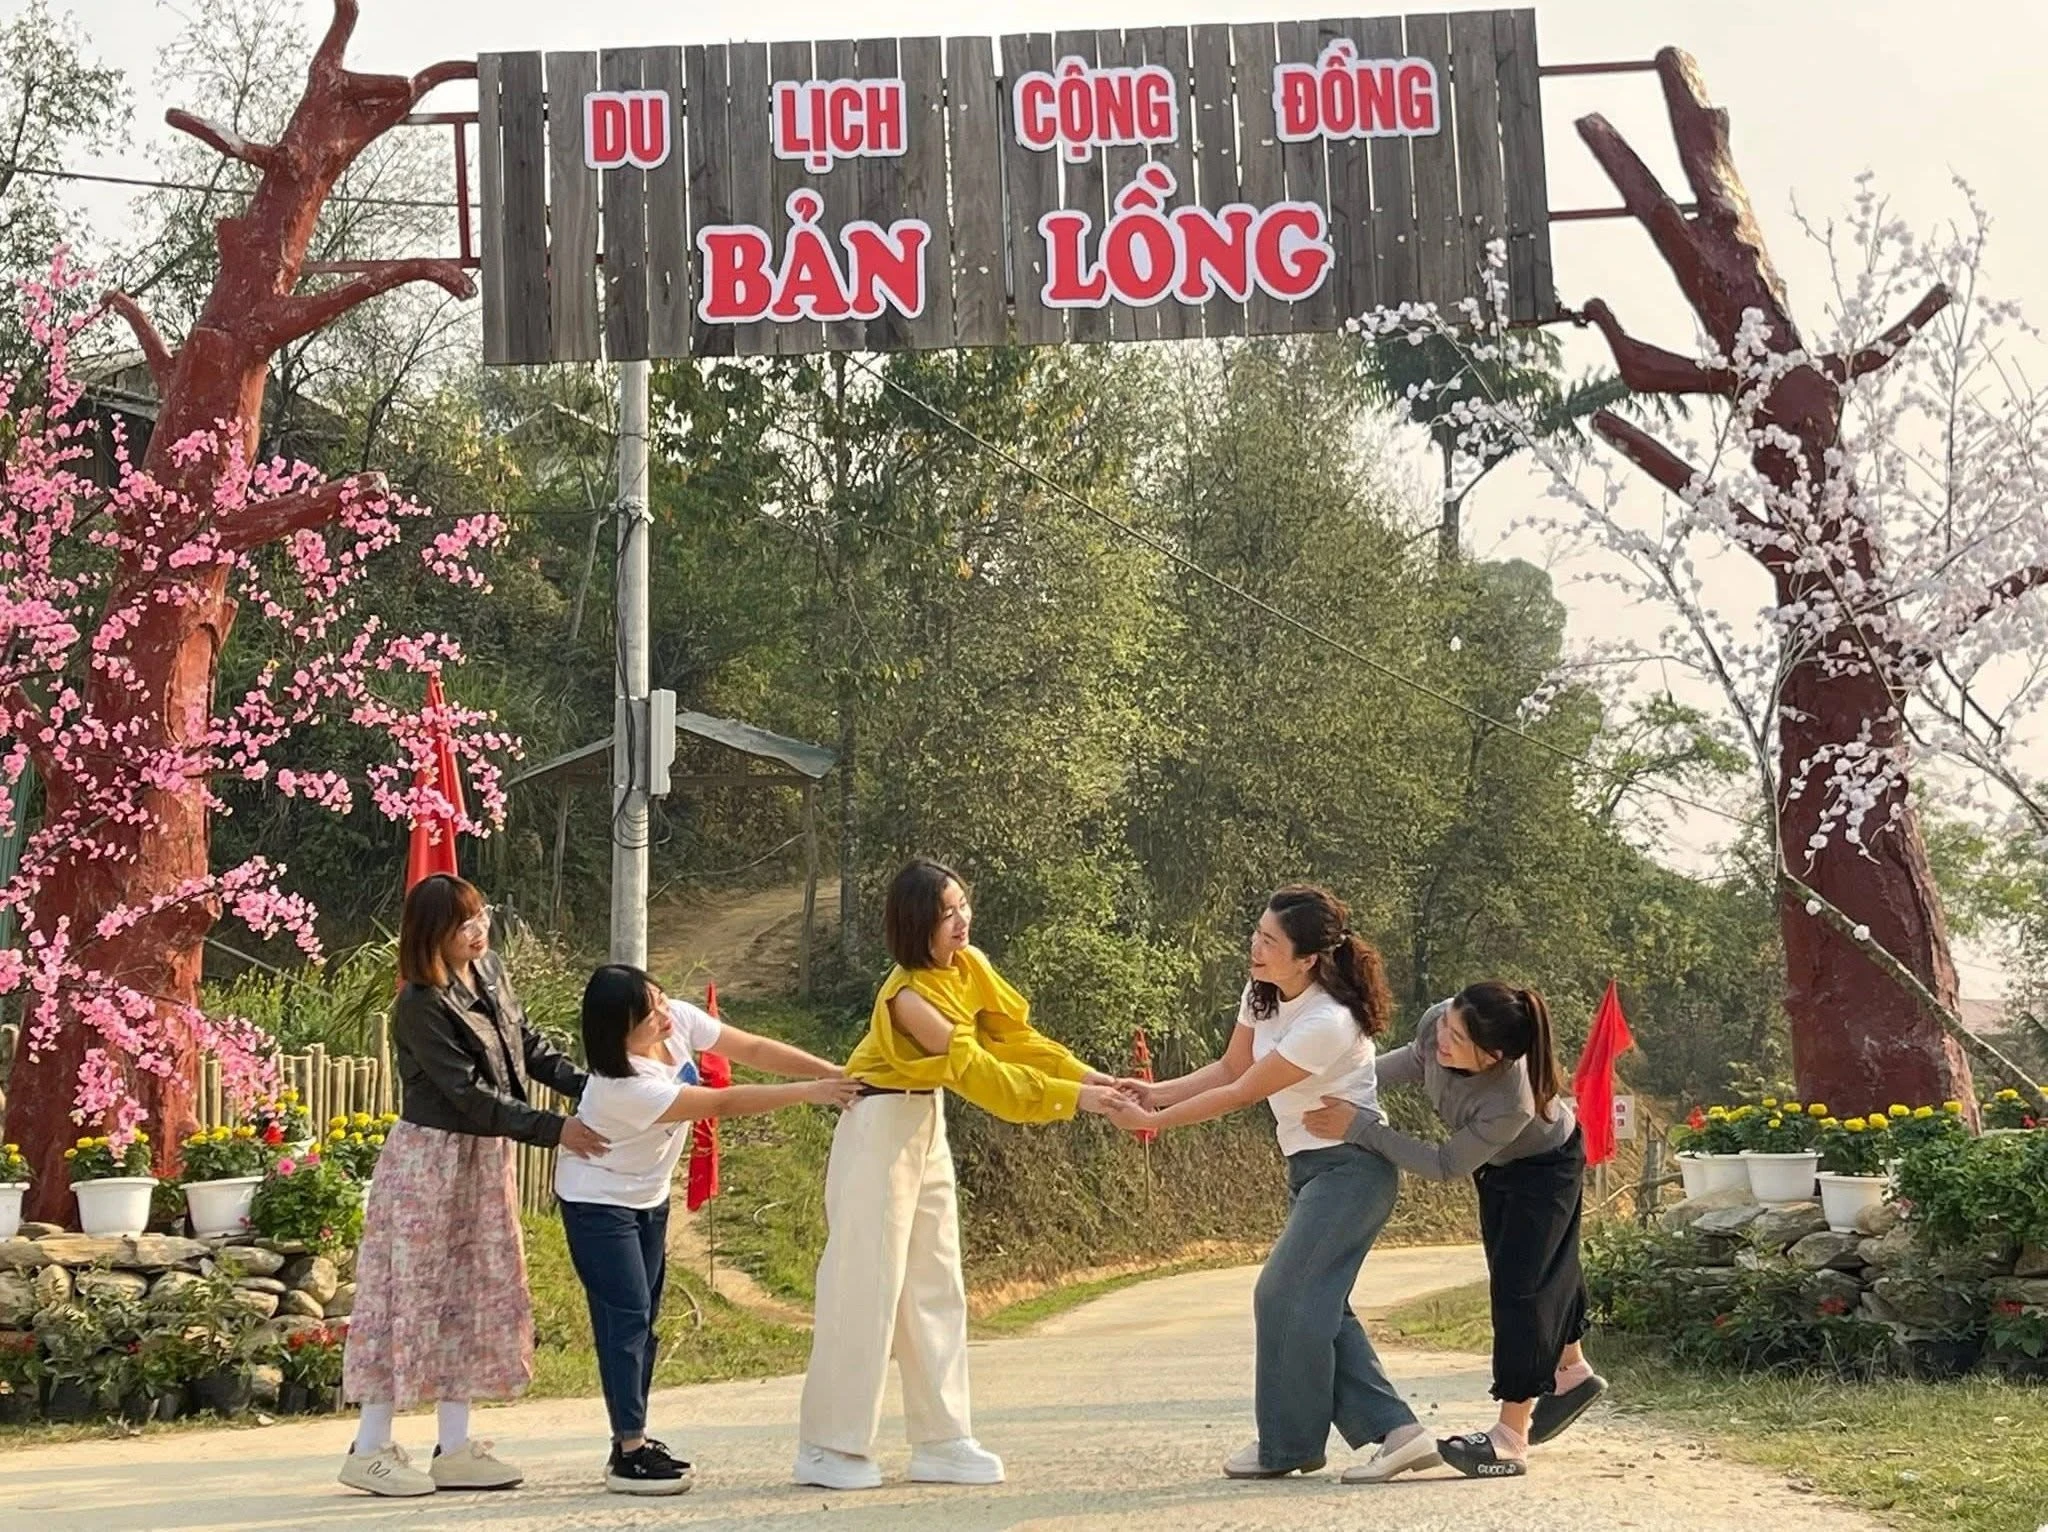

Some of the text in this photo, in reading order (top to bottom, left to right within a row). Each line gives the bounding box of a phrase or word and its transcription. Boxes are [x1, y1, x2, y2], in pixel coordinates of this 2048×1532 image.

[592, 46, 1434, 166] DU LỊCH CỘNG ĐỒNG
[705, 168, 1327, 317] BẢN LỒNG
